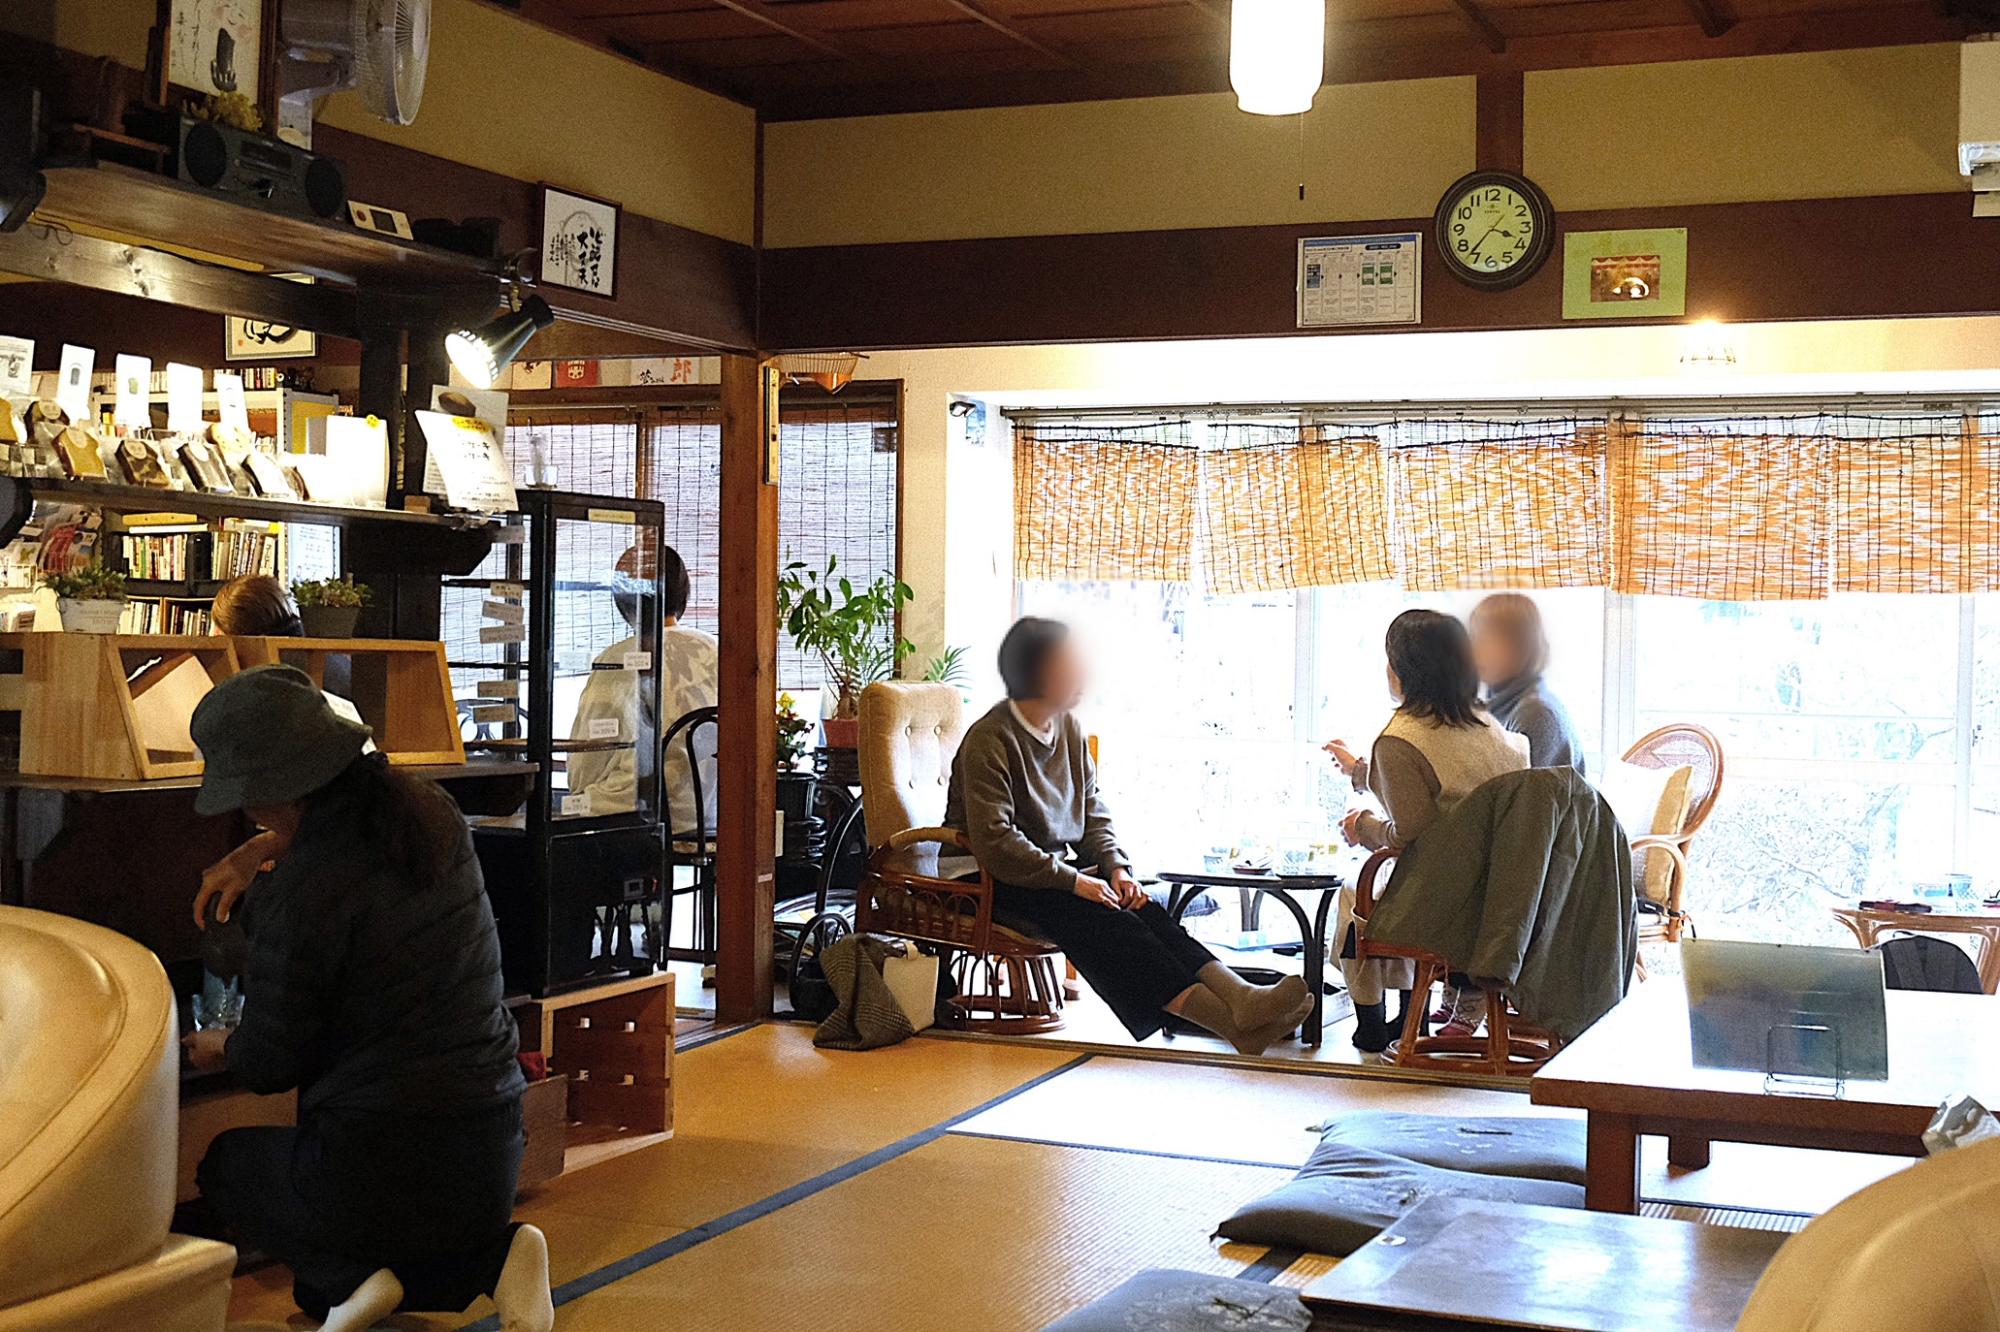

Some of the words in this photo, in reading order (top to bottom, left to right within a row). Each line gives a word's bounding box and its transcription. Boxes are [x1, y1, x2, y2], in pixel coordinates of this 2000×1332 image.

[1470, 194, 1481, 207] 11
[1485, 188, 1501, 201] 12
[1508, 194, 1512, 206] 1
[1458, 206, 1472, 220] 10
[1515, 204, 1527, 217] 2
[1453, 223, 1466, 236] 9
[1519, 221, 1532, 234] 3
[1457, 239, 1469, 252] 8
[1513, 237, 1526, 250] 4
[1469, 252, 1481, 264] 7
[1485, 256, 1498, 268] 6
[1501, 251, 1513, 264] 5
